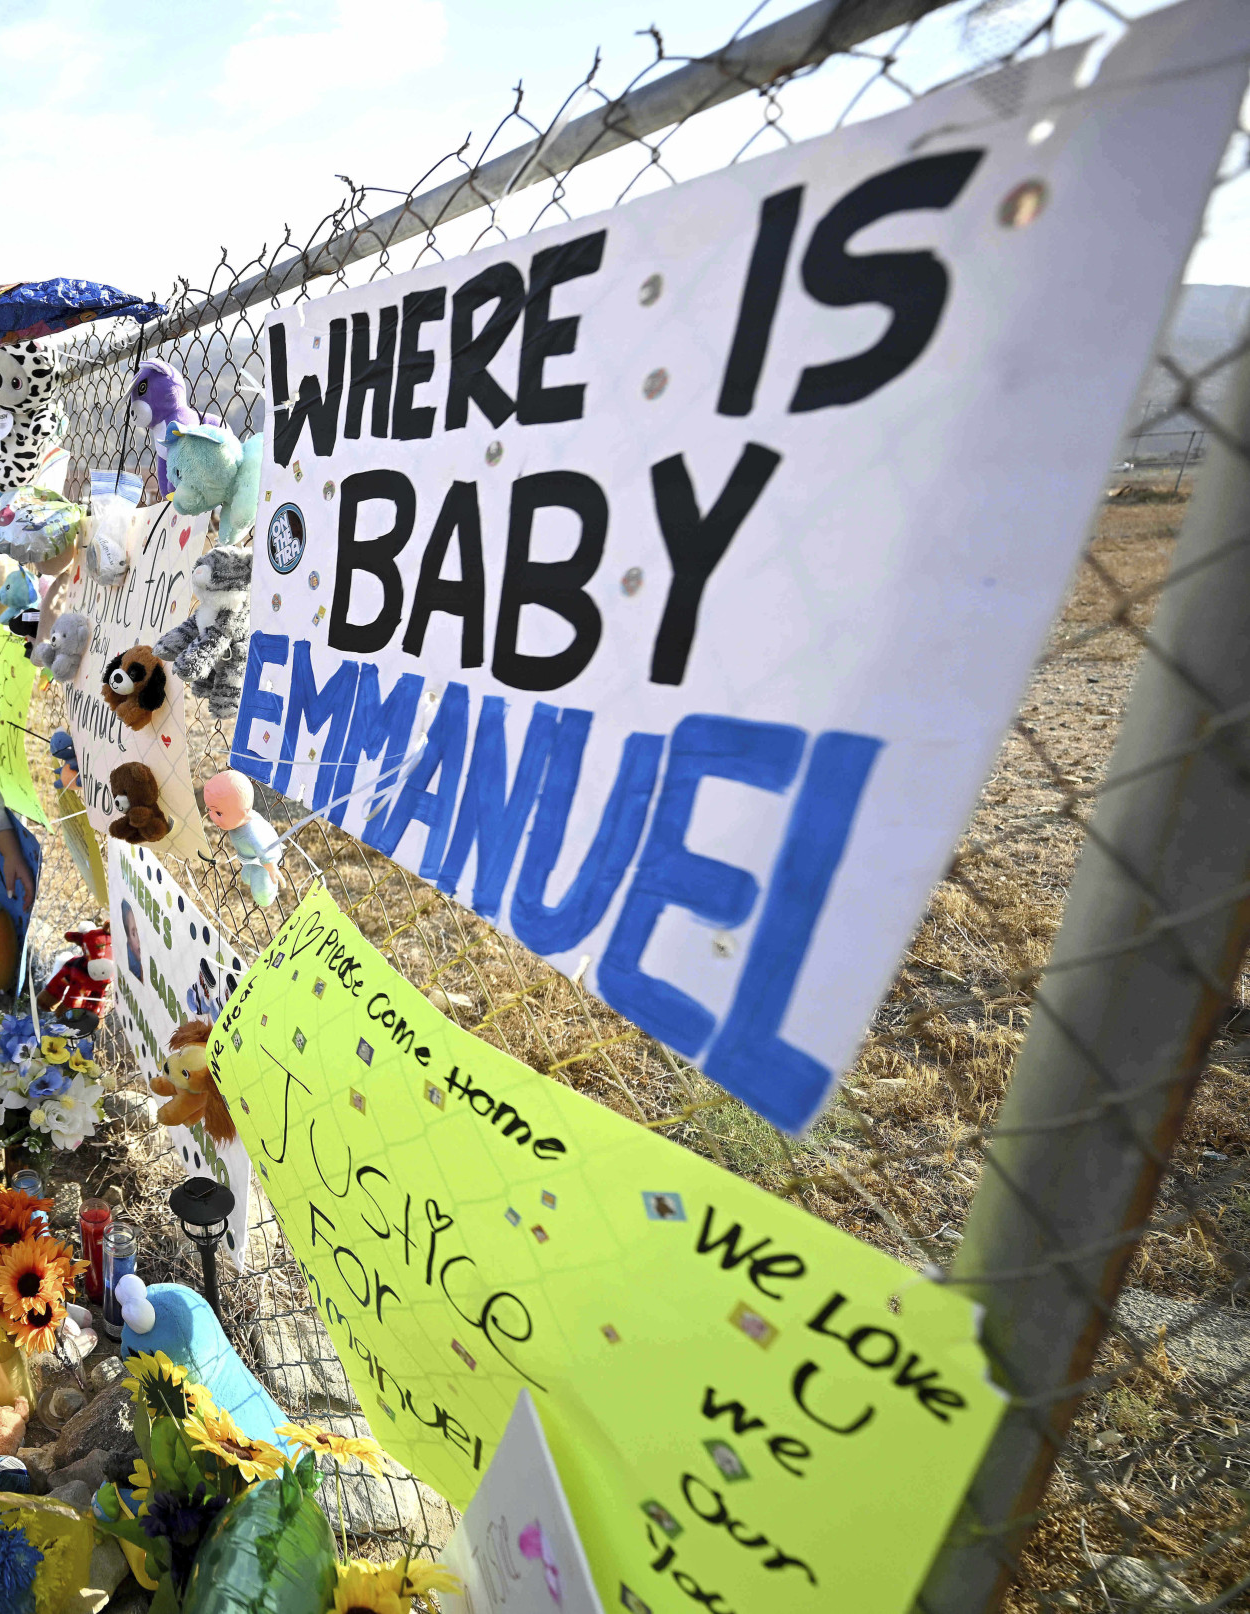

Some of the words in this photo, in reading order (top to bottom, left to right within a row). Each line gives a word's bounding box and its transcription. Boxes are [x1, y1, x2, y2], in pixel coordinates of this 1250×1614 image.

[269, 229, 607, 467] WHERE
[716, 148, 986, 417] IS
[272, 512, 289, 538] ON
[274, 527, 293, 553] THE
[276, 539, 300, 568] TIRA
[327, 441, 782, 692] BABY
[120, 850, 172, 950] WHERE'S
[228, 630, 886, 1138] EMMANUEL
[117, 964, 167, 1074] EMMANU
[190, 1121, 230, 1189] ARO
[297, 1256, 482, 1471] mmanuel
